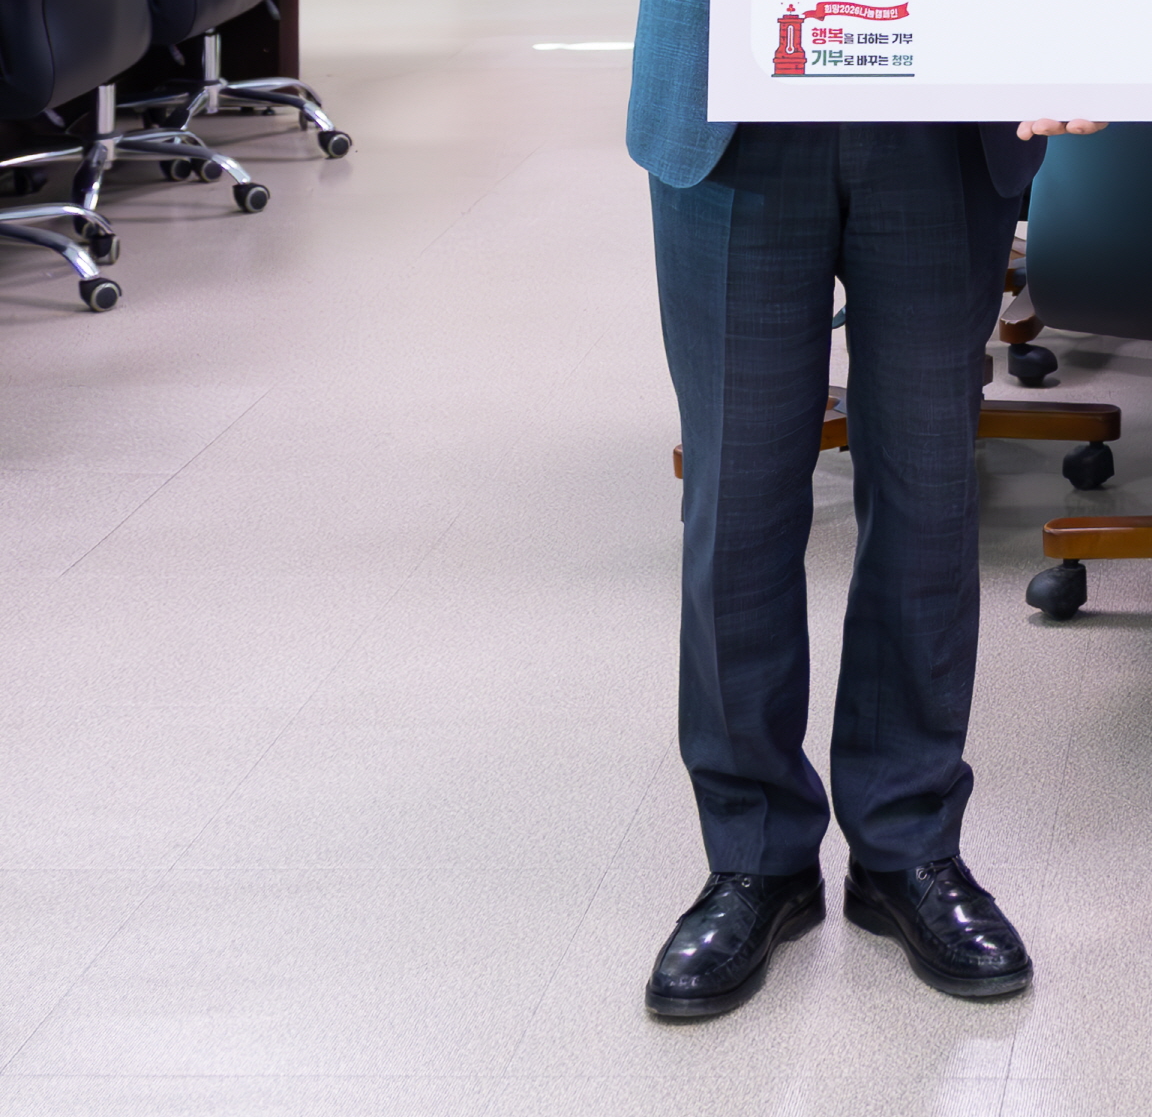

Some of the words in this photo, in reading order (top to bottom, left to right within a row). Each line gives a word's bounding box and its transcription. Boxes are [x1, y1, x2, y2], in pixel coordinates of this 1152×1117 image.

[824, 4, 898, 18] 희망2026나눔캠페인
[811, 27, 854, 45] 행복을
[857, 33, 889, 45] 더하는
[892, 33, 913, 45] 기부
[811, 50, 854, 66] 기부로
[857, 55, 889, 66] 바꾸는
[892, 55, 913, 66] 청양
